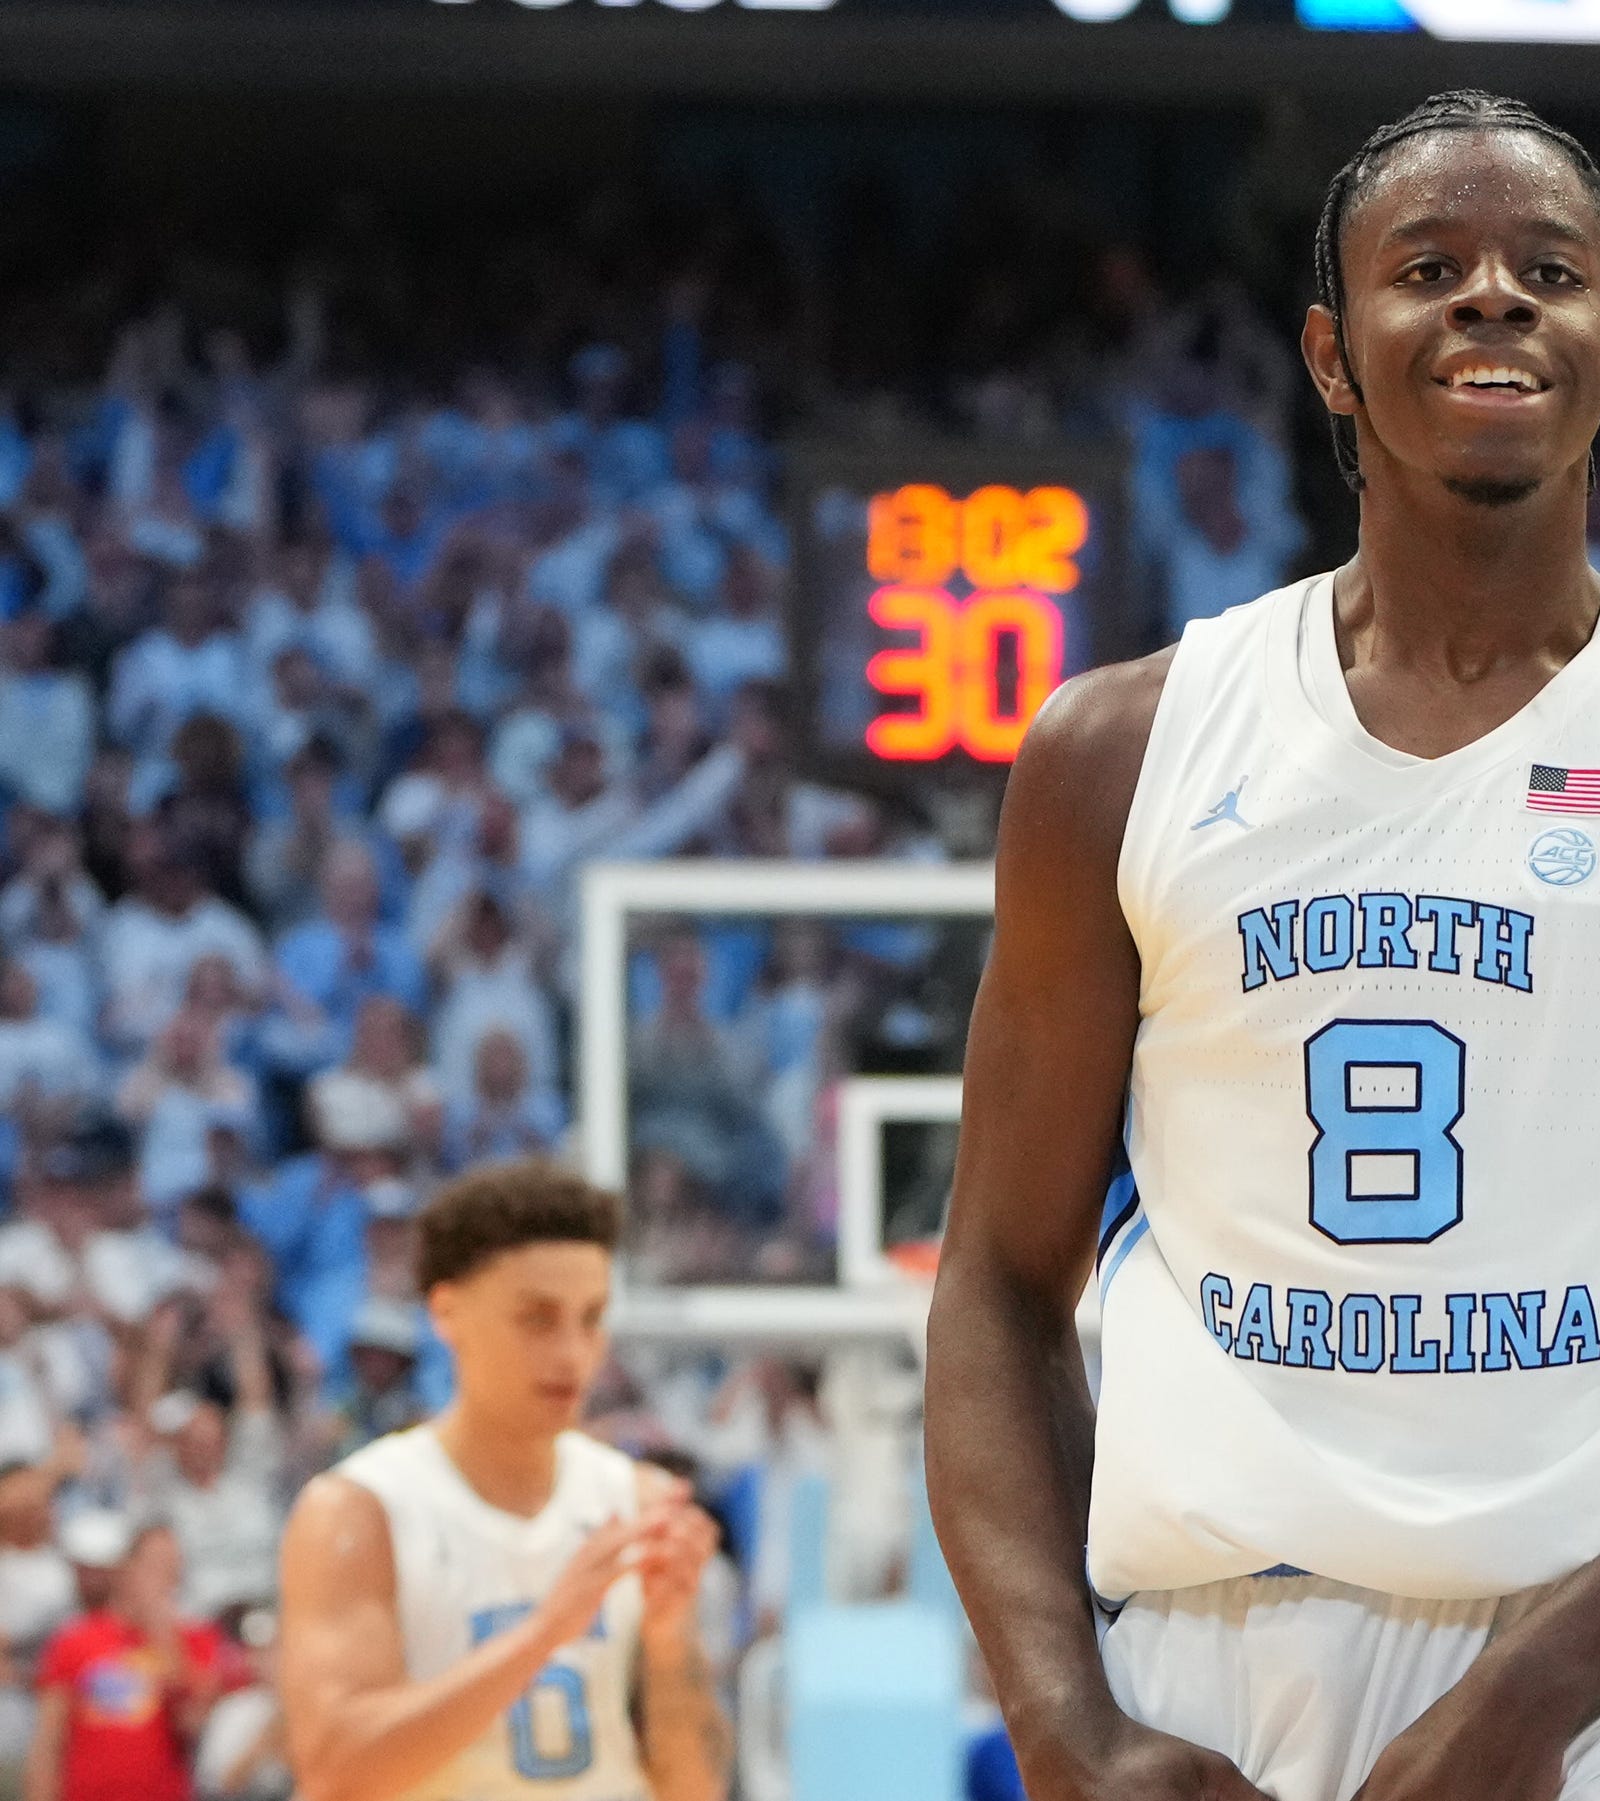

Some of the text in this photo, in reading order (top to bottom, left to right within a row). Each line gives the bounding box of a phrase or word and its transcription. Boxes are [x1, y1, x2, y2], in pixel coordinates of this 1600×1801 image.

[866, 585, 1064, 762] 30
[1538, 845, 1594, 866] ACC
[1237, 893, 1535, 994] NORTH
[1304, 1018, 1466, 1246] 8
[509, 1664, 592, 1781] 0
